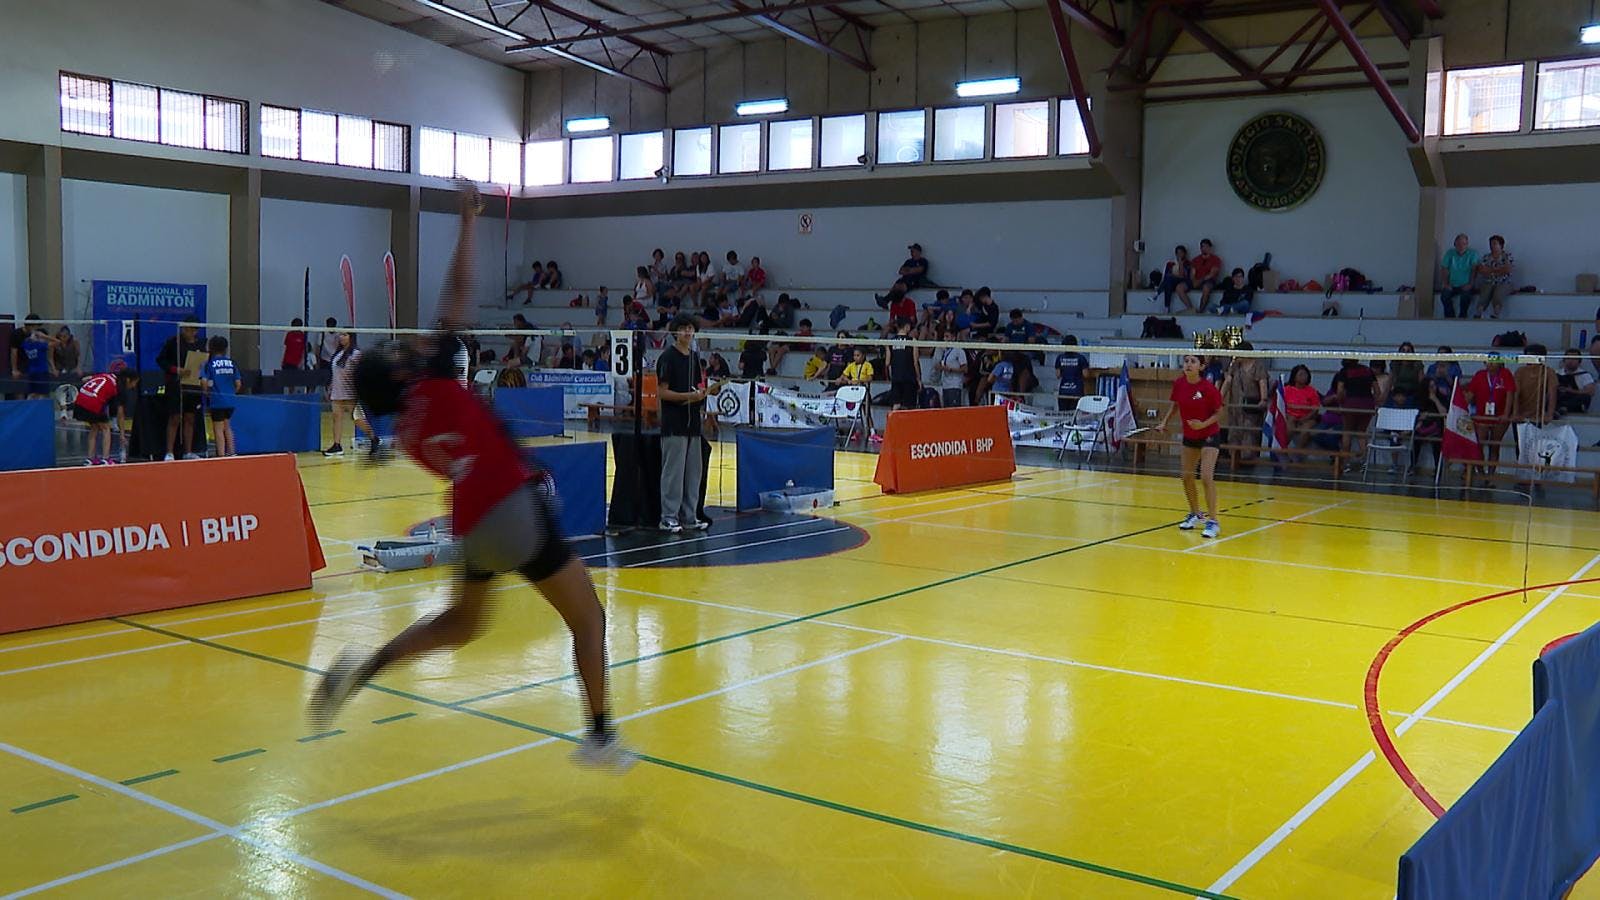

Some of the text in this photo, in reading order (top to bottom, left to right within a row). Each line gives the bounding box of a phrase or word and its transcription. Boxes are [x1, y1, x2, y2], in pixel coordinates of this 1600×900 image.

[1231, 118, 1270, 177] COLEGIO
[106, 293, 195, 308] BADMINTON
[107, 284, 195, 296] INTERNACIONAL DE
[615, 343, 629, 376] 3
[530, 374, 543, 382] Club
[910, 437, 994, 460] ESCONDIDA BHP
[0, 514, 258, 569] CONDIDA BHP
